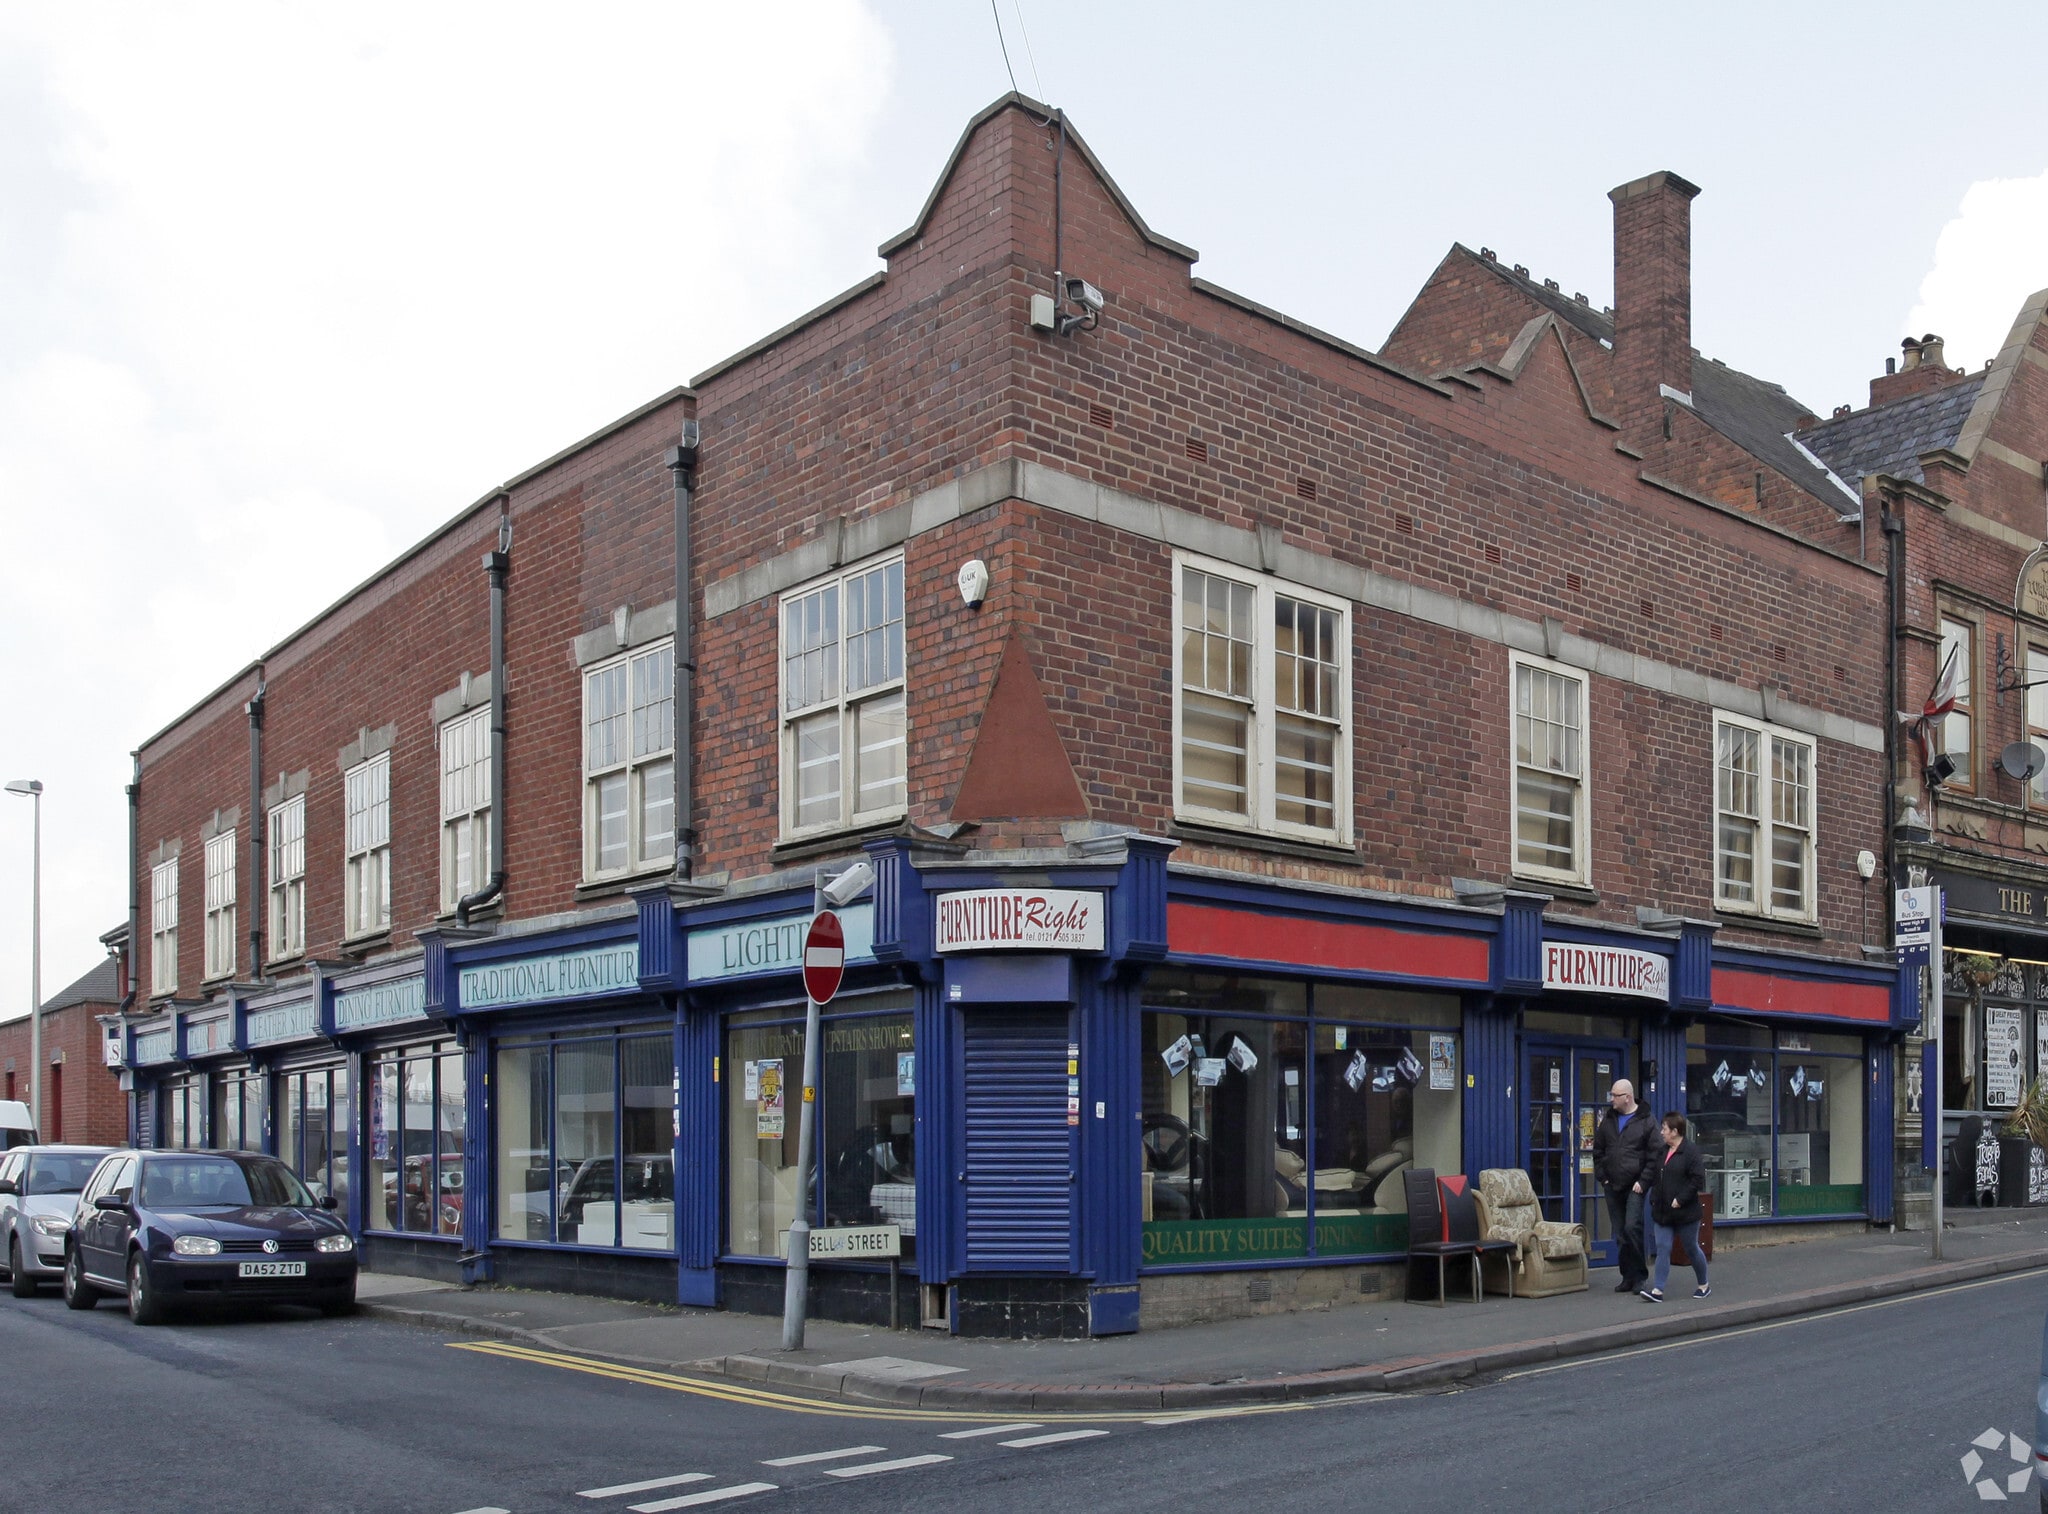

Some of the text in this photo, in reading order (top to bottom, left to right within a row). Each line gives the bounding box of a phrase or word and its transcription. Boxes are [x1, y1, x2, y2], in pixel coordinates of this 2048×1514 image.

[1998, 888, 2032, 915] THE
[941, 896, 1088, 944] FURNITURE Right
[1058, 933, 1070, 942] 505
[1071, 933, 1085, 943] 3837
[463, 950, 637, 1003] TRADITIONAL FURNITUR
[1548, 947, 1643, 990] FURNITURE
[338, 982, 425, 1025] DINING FURNITUR
[253, 1012, 287, 1040] LEATHER
[848, 1233, 889, 1250] STREET
[1142, 1228, 1231, 1259] QUALITY
[1237, 1227, 1301, 1250] SUITES
[245, 1263, 302, 1275] DA52 ZTD
